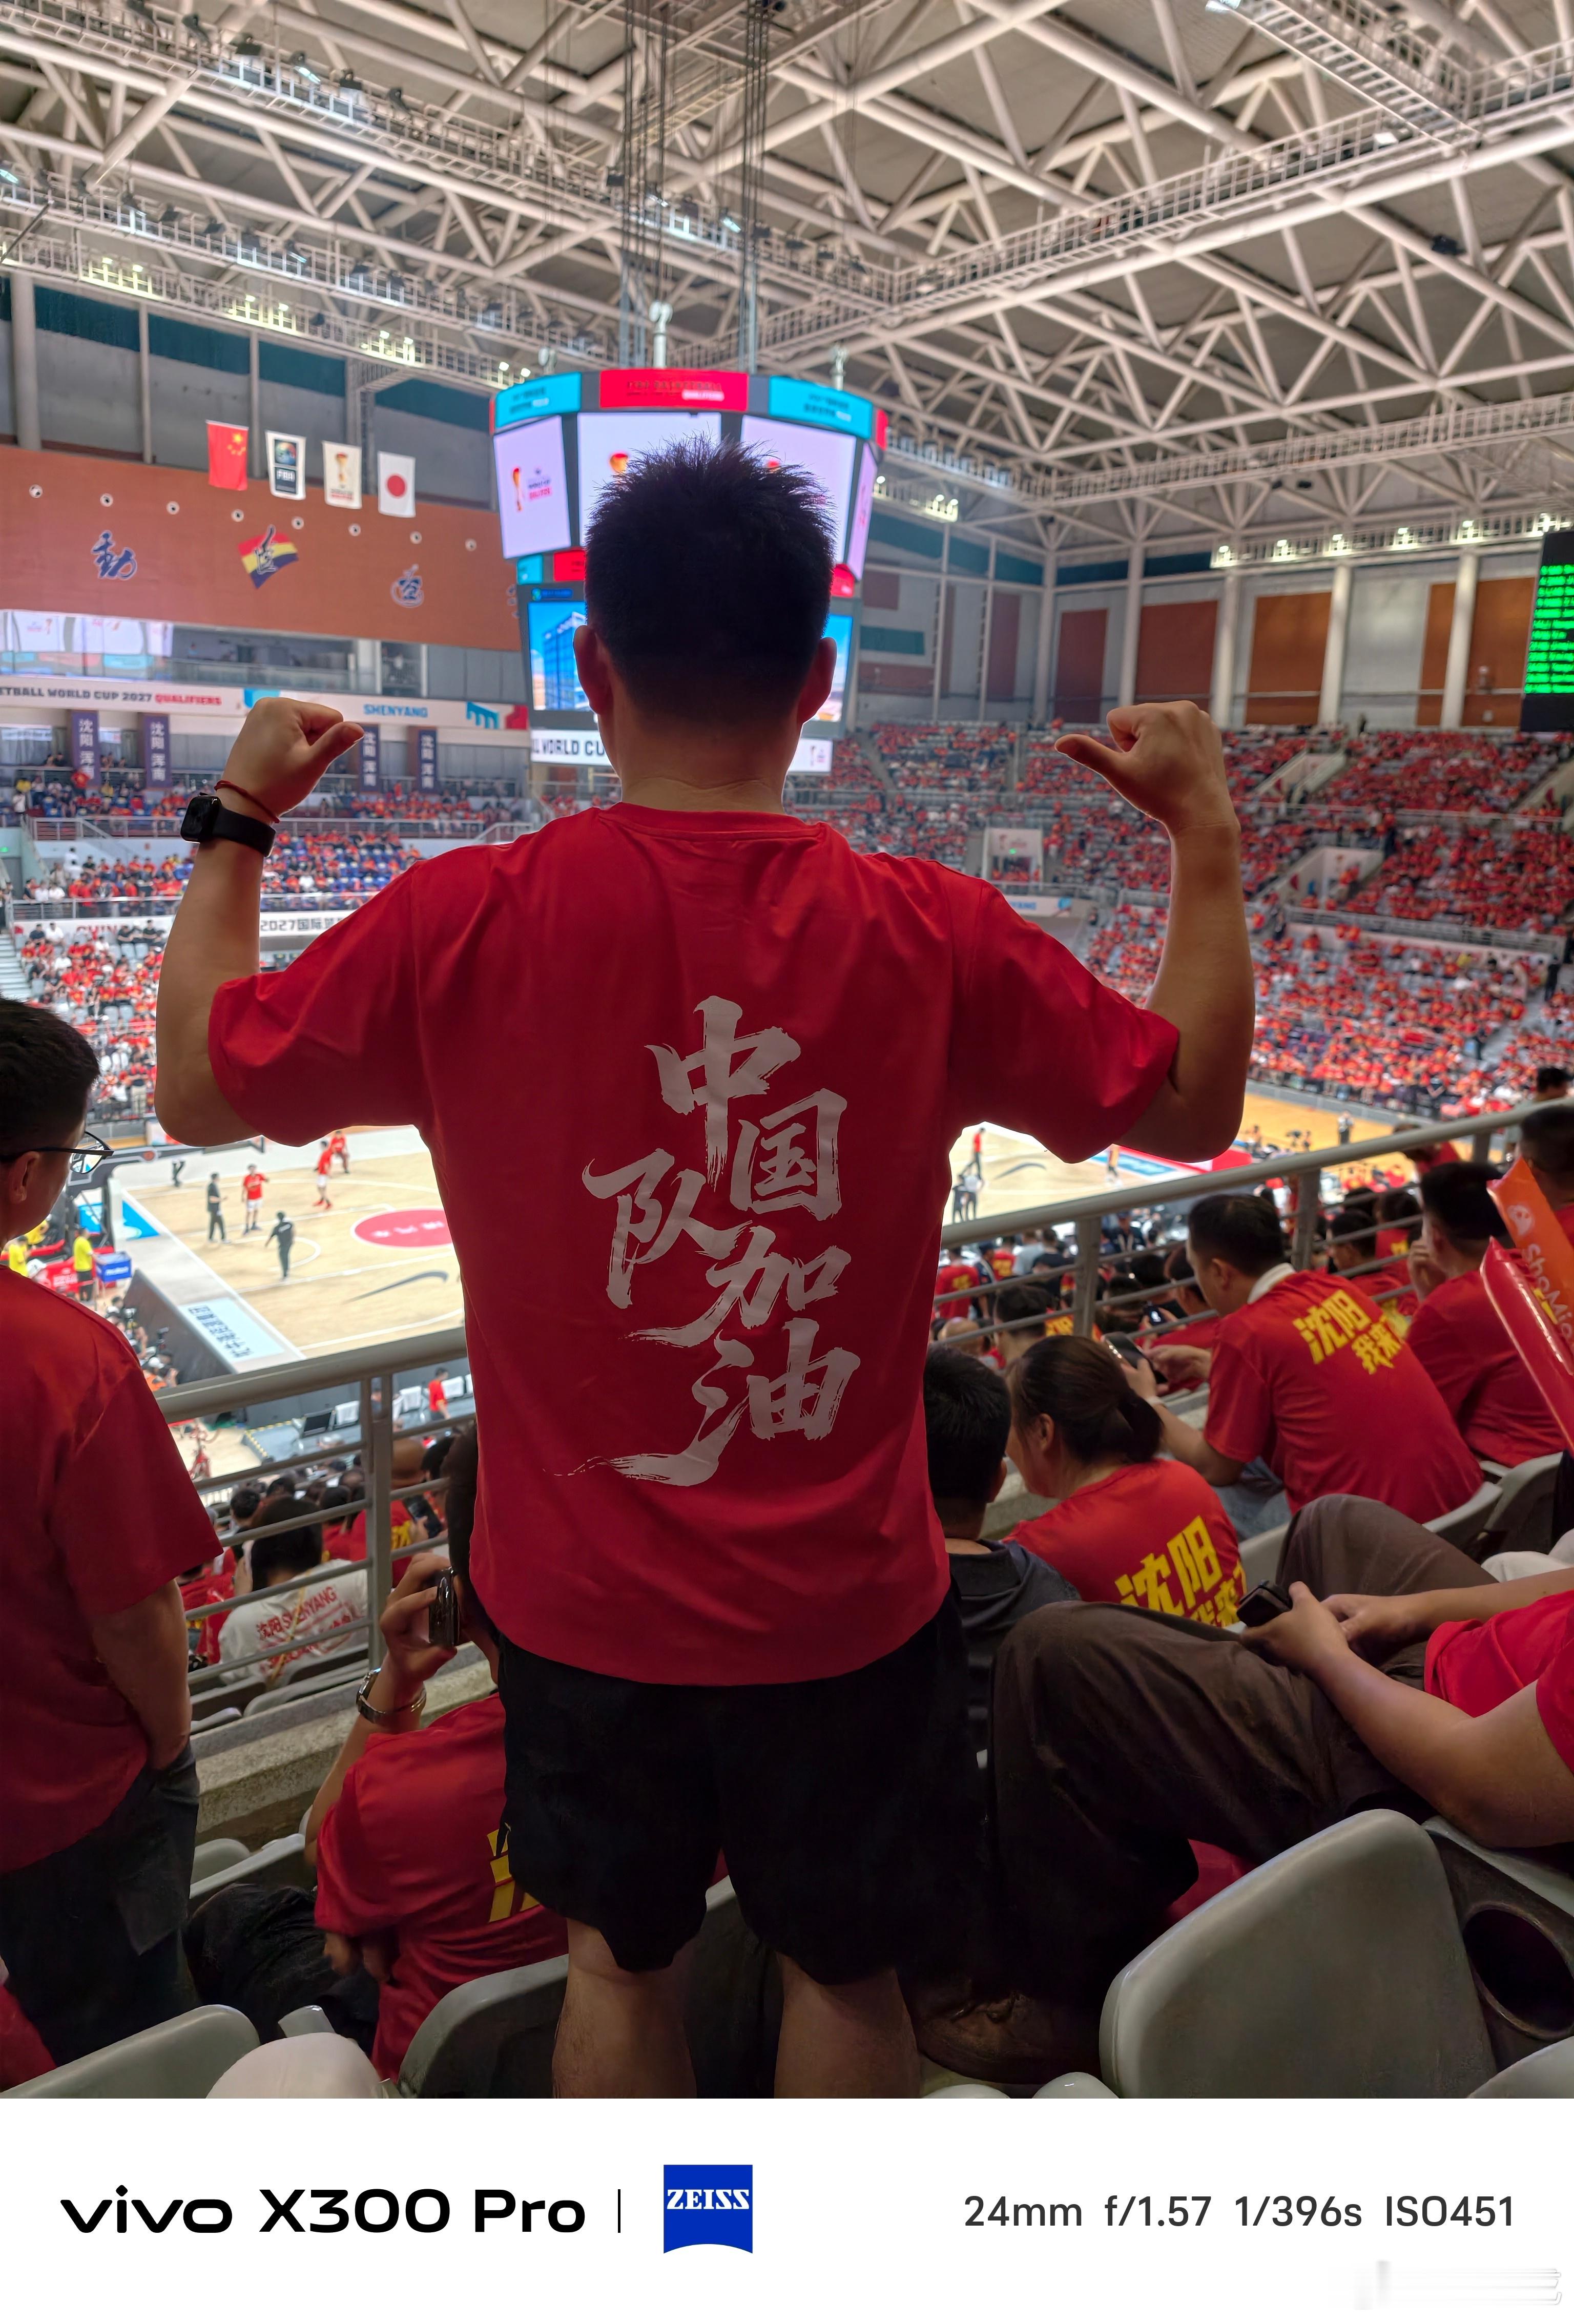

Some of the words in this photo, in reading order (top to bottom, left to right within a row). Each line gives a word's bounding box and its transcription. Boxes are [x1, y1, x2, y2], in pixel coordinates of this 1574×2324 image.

[48, 688, 91, 700] WORLD
[94, 691, 119, 700] CUP
[122, 692, 153, 702] 2027
[155, 693, 222, 706] QUALIFIERS
[363, 703, 428, 718] SHENYANG
[1292, 1289, 1372, 1364] 沈阳
[1351, 1313, 1402, 1375] 我来
[1114, 1515, 1223, 1617] 沈阳
